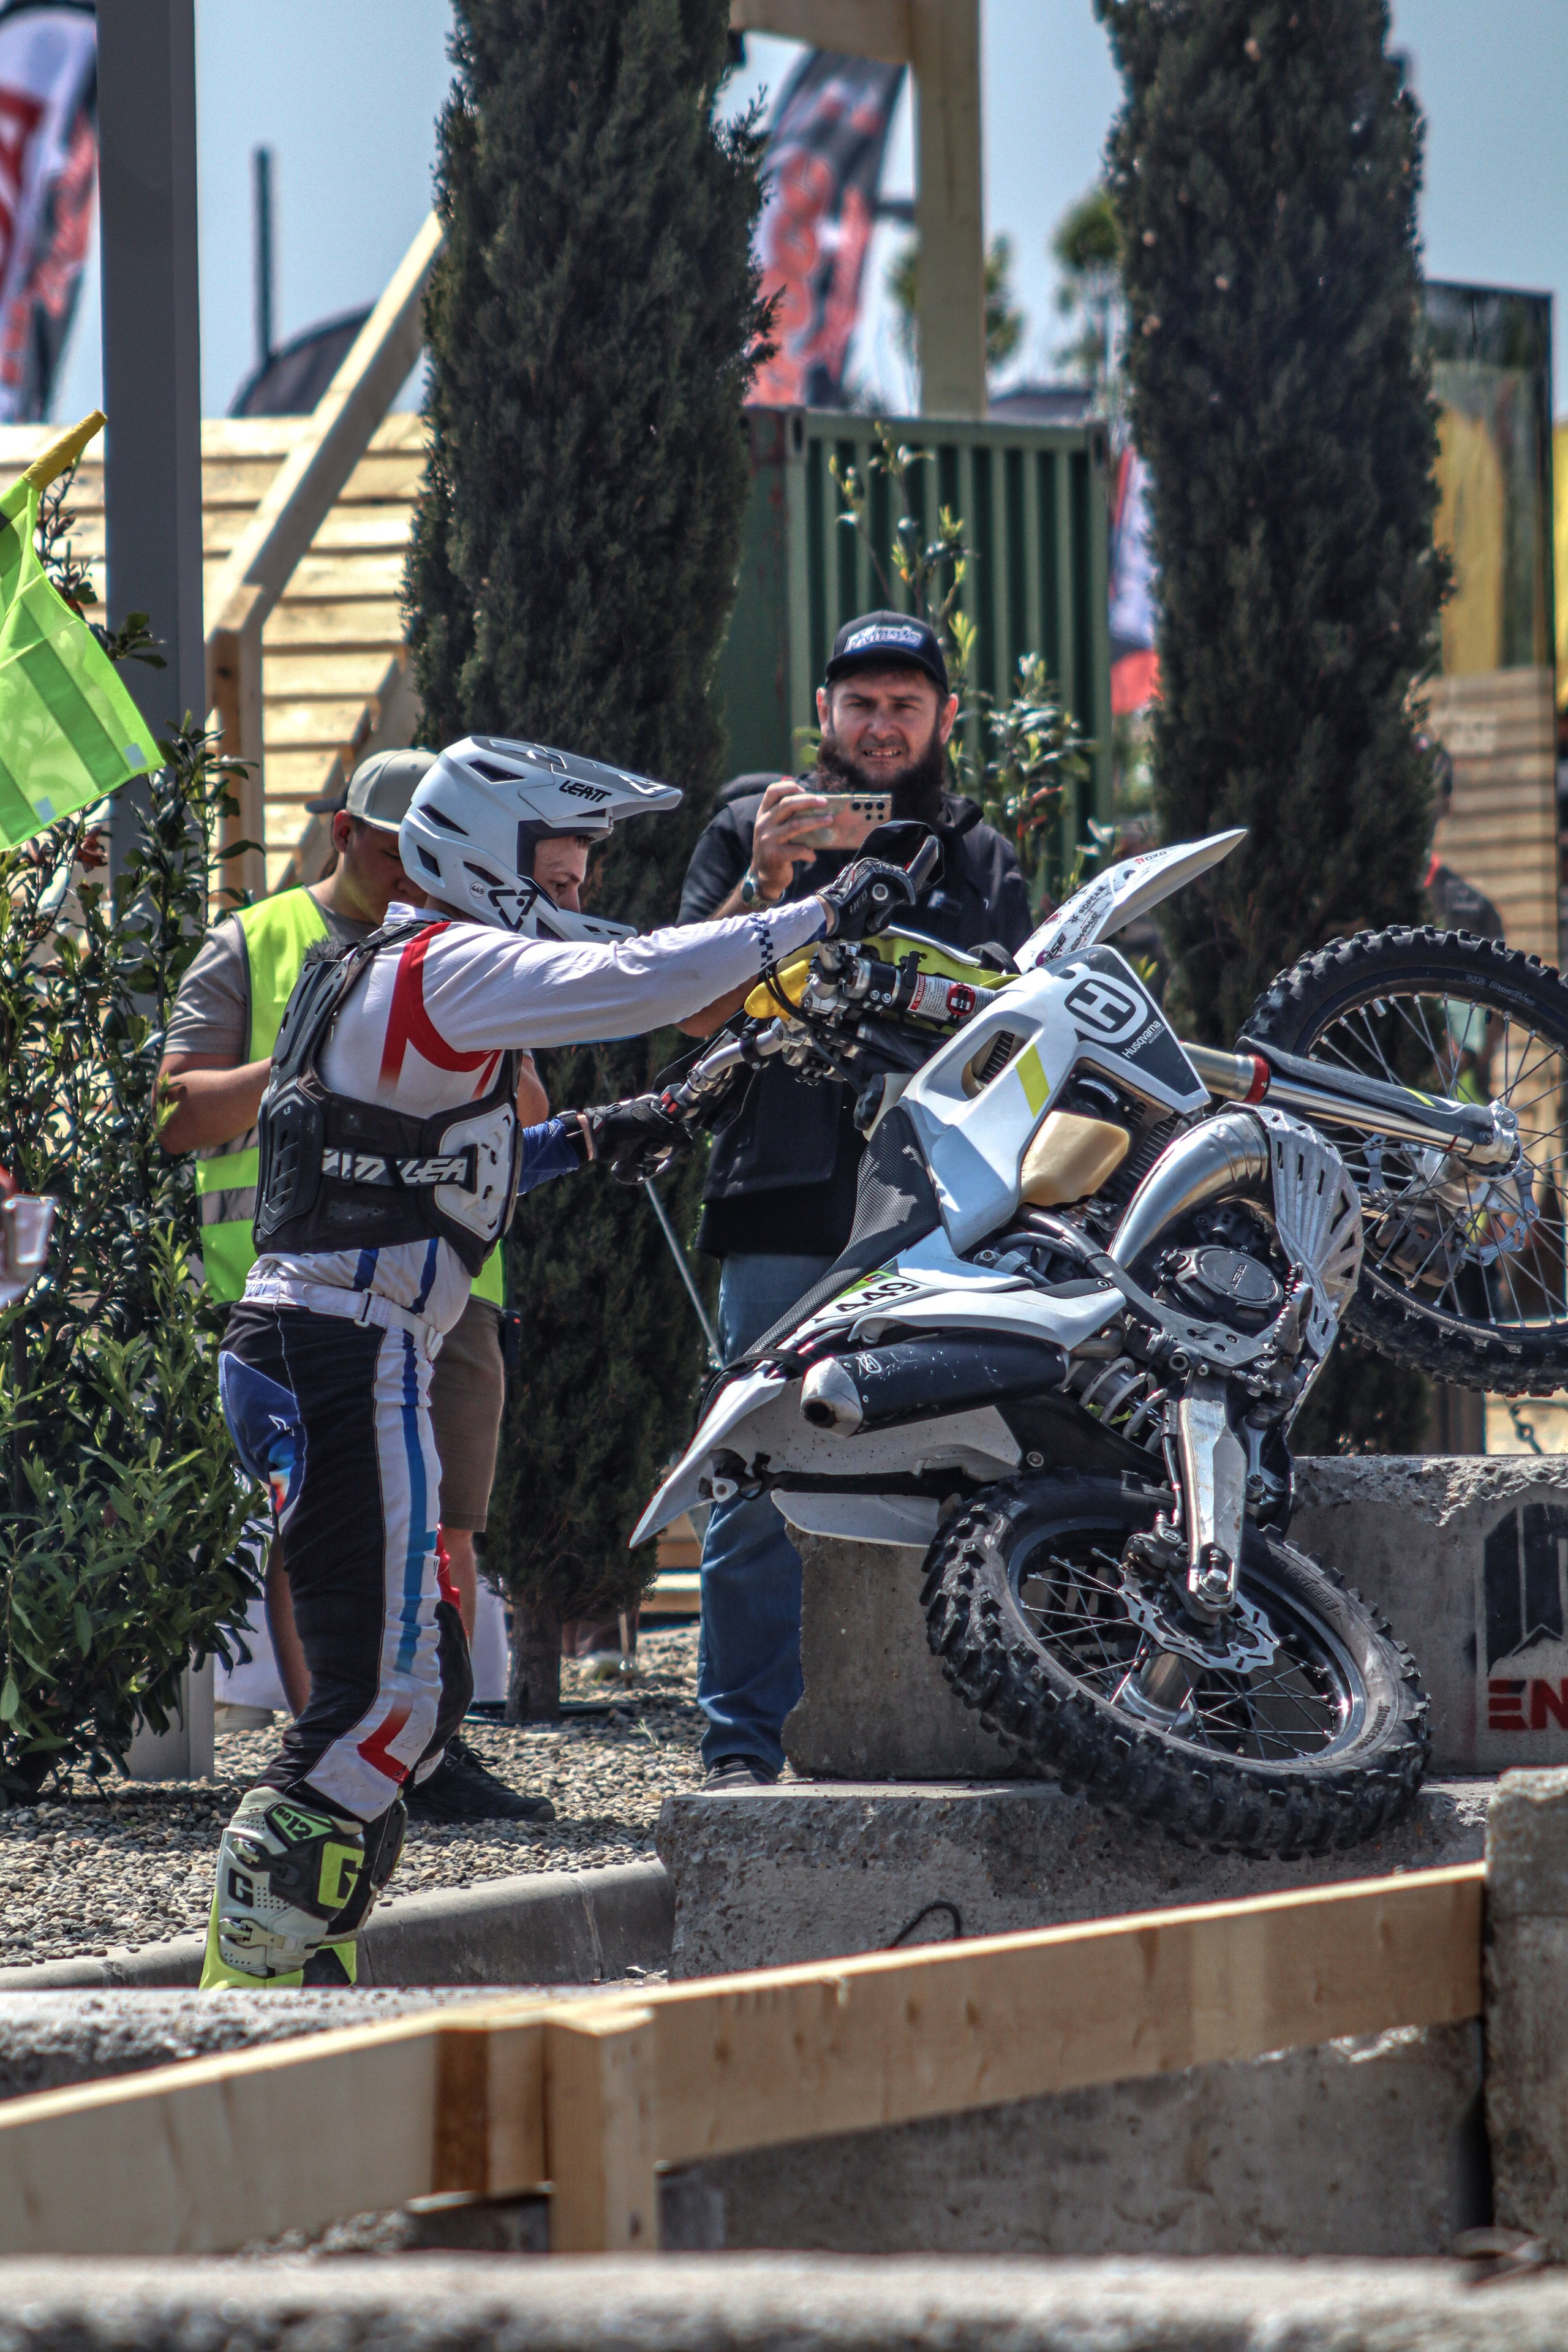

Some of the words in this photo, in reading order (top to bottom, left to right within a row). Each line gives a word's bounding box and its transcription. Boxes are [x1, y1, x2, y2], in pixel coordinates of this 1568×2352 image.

[559, 780, 612, 803] LEATT
[471, 885, 484, 894] 449
[915, 974, 925, 1002] WARNING
[1121, 1020, 1162, 1059] Husqvarna
[835, 1282, 921, 1313] 449
